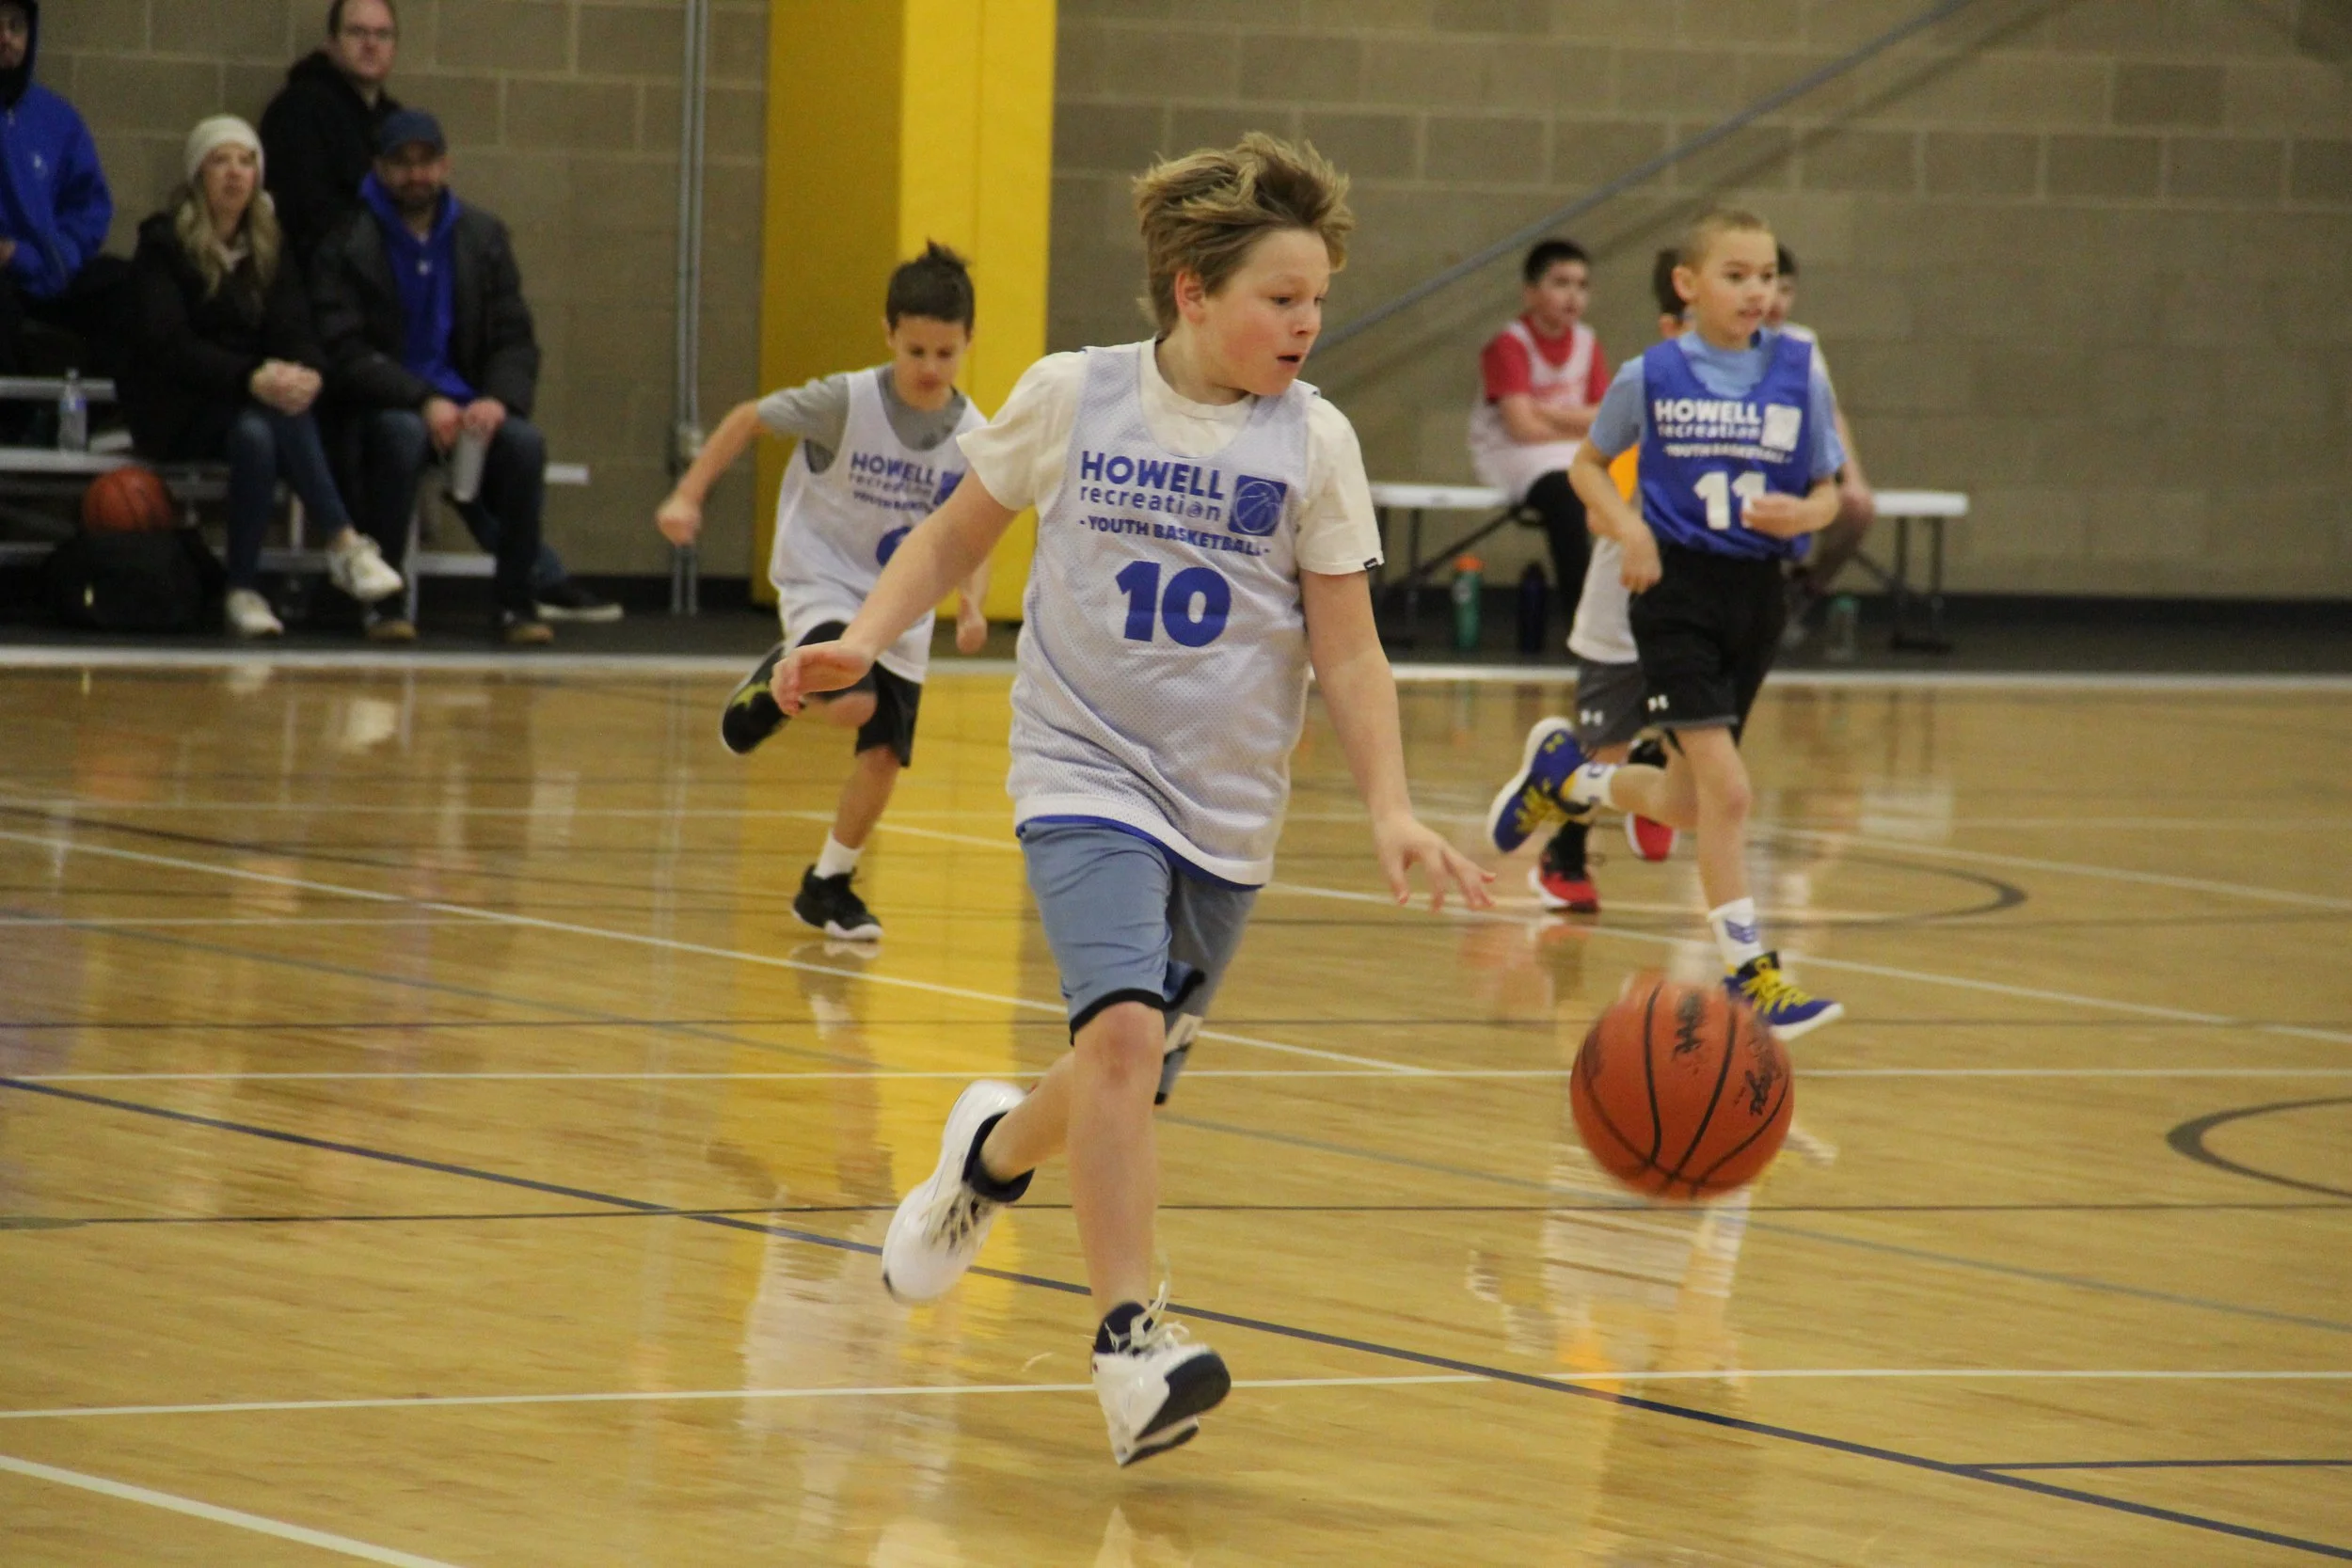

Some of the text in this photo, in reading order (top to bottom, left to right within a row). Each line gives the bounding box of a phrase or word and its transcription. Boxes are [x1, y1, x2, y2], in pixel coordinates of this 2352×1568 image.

[1654, 398, 1761, 424] HOWELL
[850, 451, 934, 485] HOWELL
[1080, 451, 1225, 500] HOWELL
[1080, 485, 1222, 521] recreation
[1694, 471, 1766, 530] 11
[1088, 515, 1149, 535] YOUTH
[1115, 560, 1232, 648] 10
